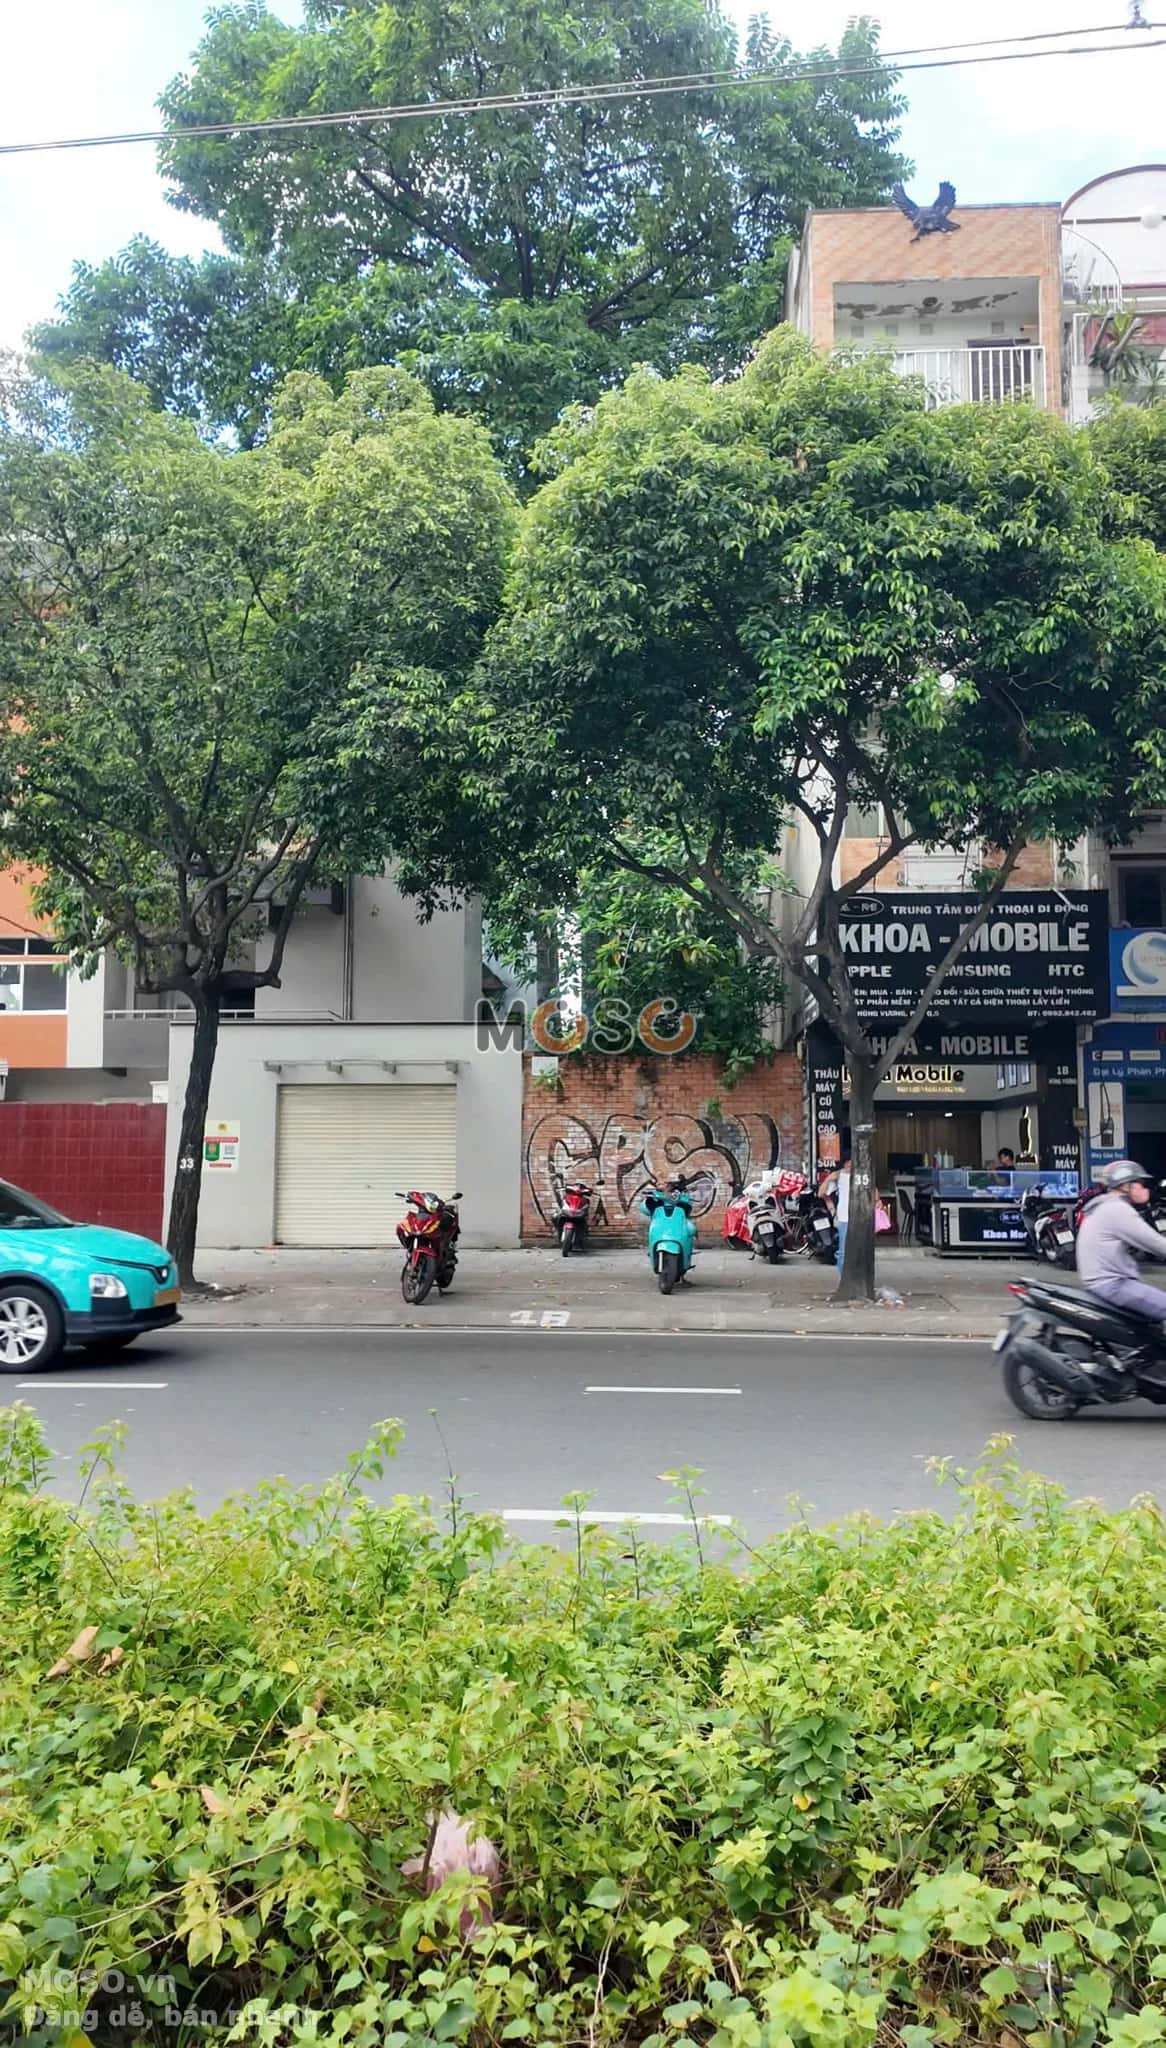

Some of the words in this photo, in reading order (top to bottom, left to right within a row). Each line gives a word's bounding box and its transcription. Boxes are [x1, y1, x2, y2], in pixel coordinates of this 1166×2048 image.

[891, 905, 932, 915] TRUNG
[935, 903, 962, 915] TÂM
[997, 904, 1034, 916] THOẠI
[1038, 904, 1051, 913] DI
[838, 922, 932, 953] KHOA
[959, 921, 1090, 952] MOBILE
[848, 965, 892, 978] PPLE
[925, 964, 1012, 977] SMSUNG
[1048, 964, 1085, 977] HTC
[940, 1036, 1029, 1055] MOBILE
[896, 1064, 964, 1082] Mobile
[815, 1081, 836, 1092] MÁY
[818, 1109, 834, 1120] GIÁ
[180, 1157, 195, 1169] 33
[1055, 1157, 1076, 1169] MÁY
[854, 1174, 870, 1185] 35
